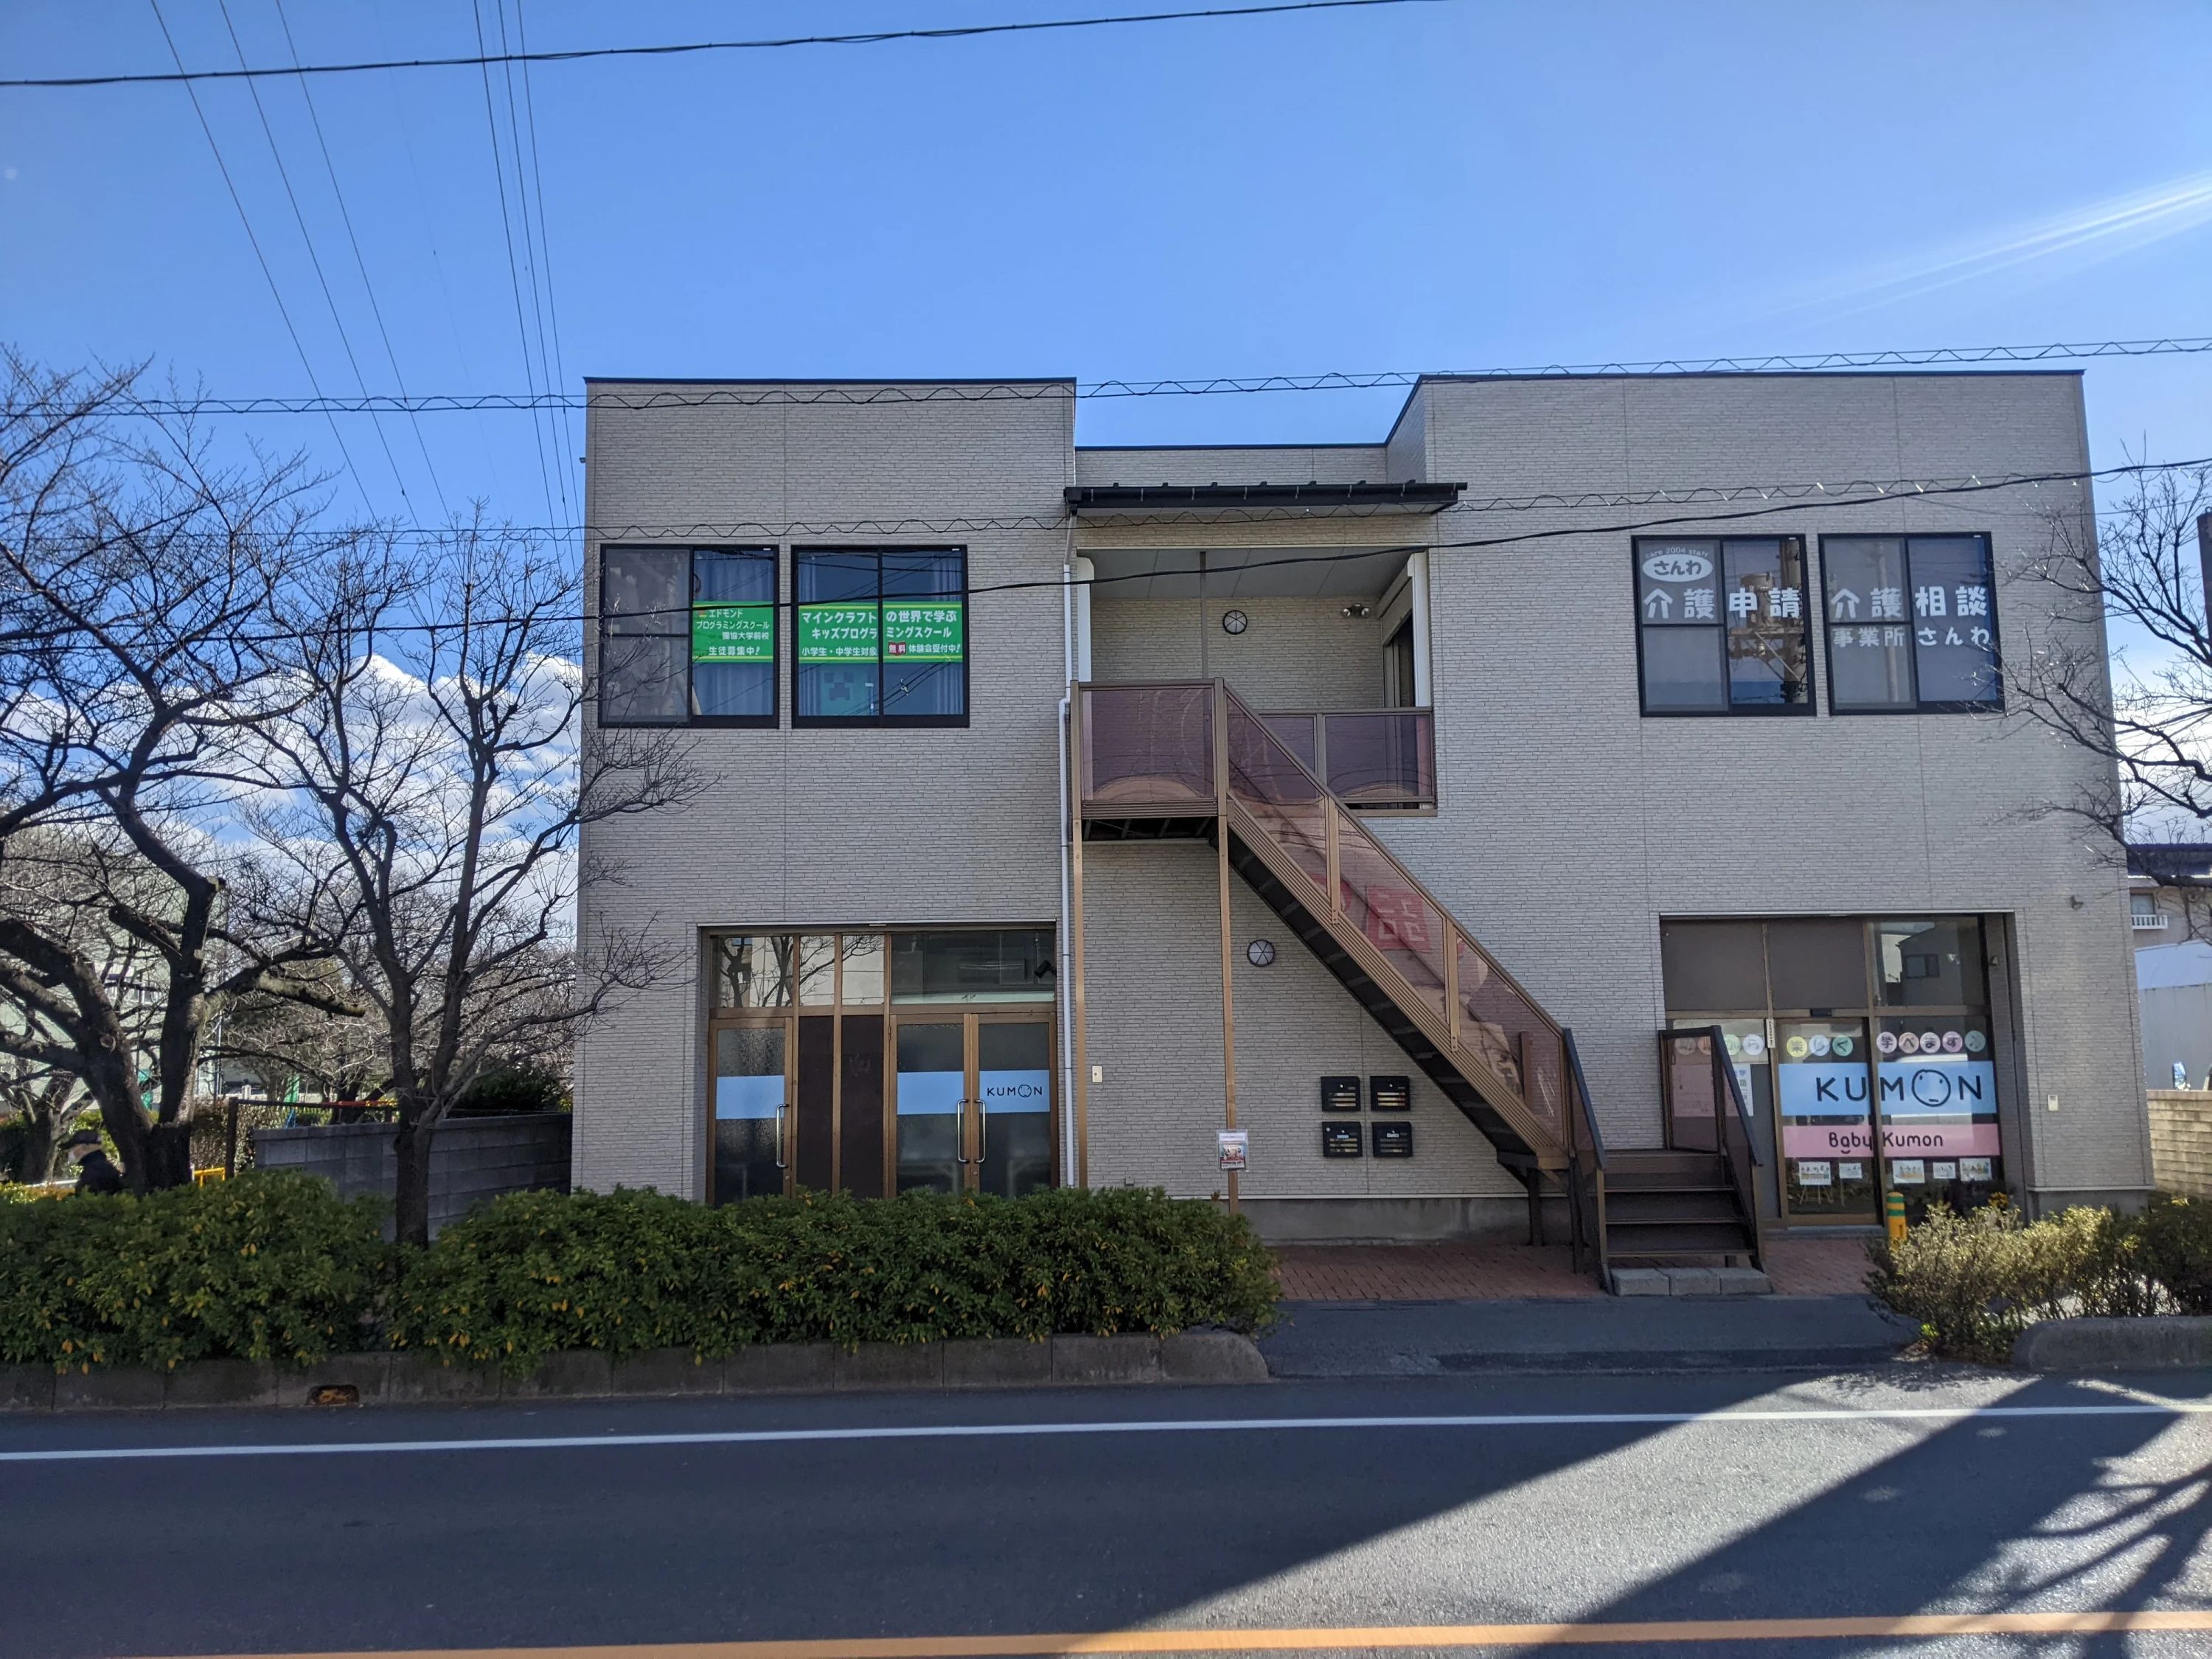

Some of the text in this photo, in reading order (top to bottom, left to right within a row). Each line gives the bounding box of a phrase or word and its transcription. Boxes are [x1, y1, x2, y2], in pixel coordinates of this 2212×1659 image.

[1645, 546, 1708, 559] care 2004 staff
[1653, 560, 1703, 576] さんわ
[1644, 587, 1800, 619] 介護申請
[1830, 585, 1988, 619] 介護相談
[709, 609, 744, 618] エドモンド
[696, 620, 770, 630] プログラミングスクール
[1832, 626, 1990, 647] 事業所 さんわ
[987, 1084, 1043, 1098] KUMON
[1815, 1068, 1982, 1107] KUMON
[1829, 1132, 1944, 1152] Baby Kumon
